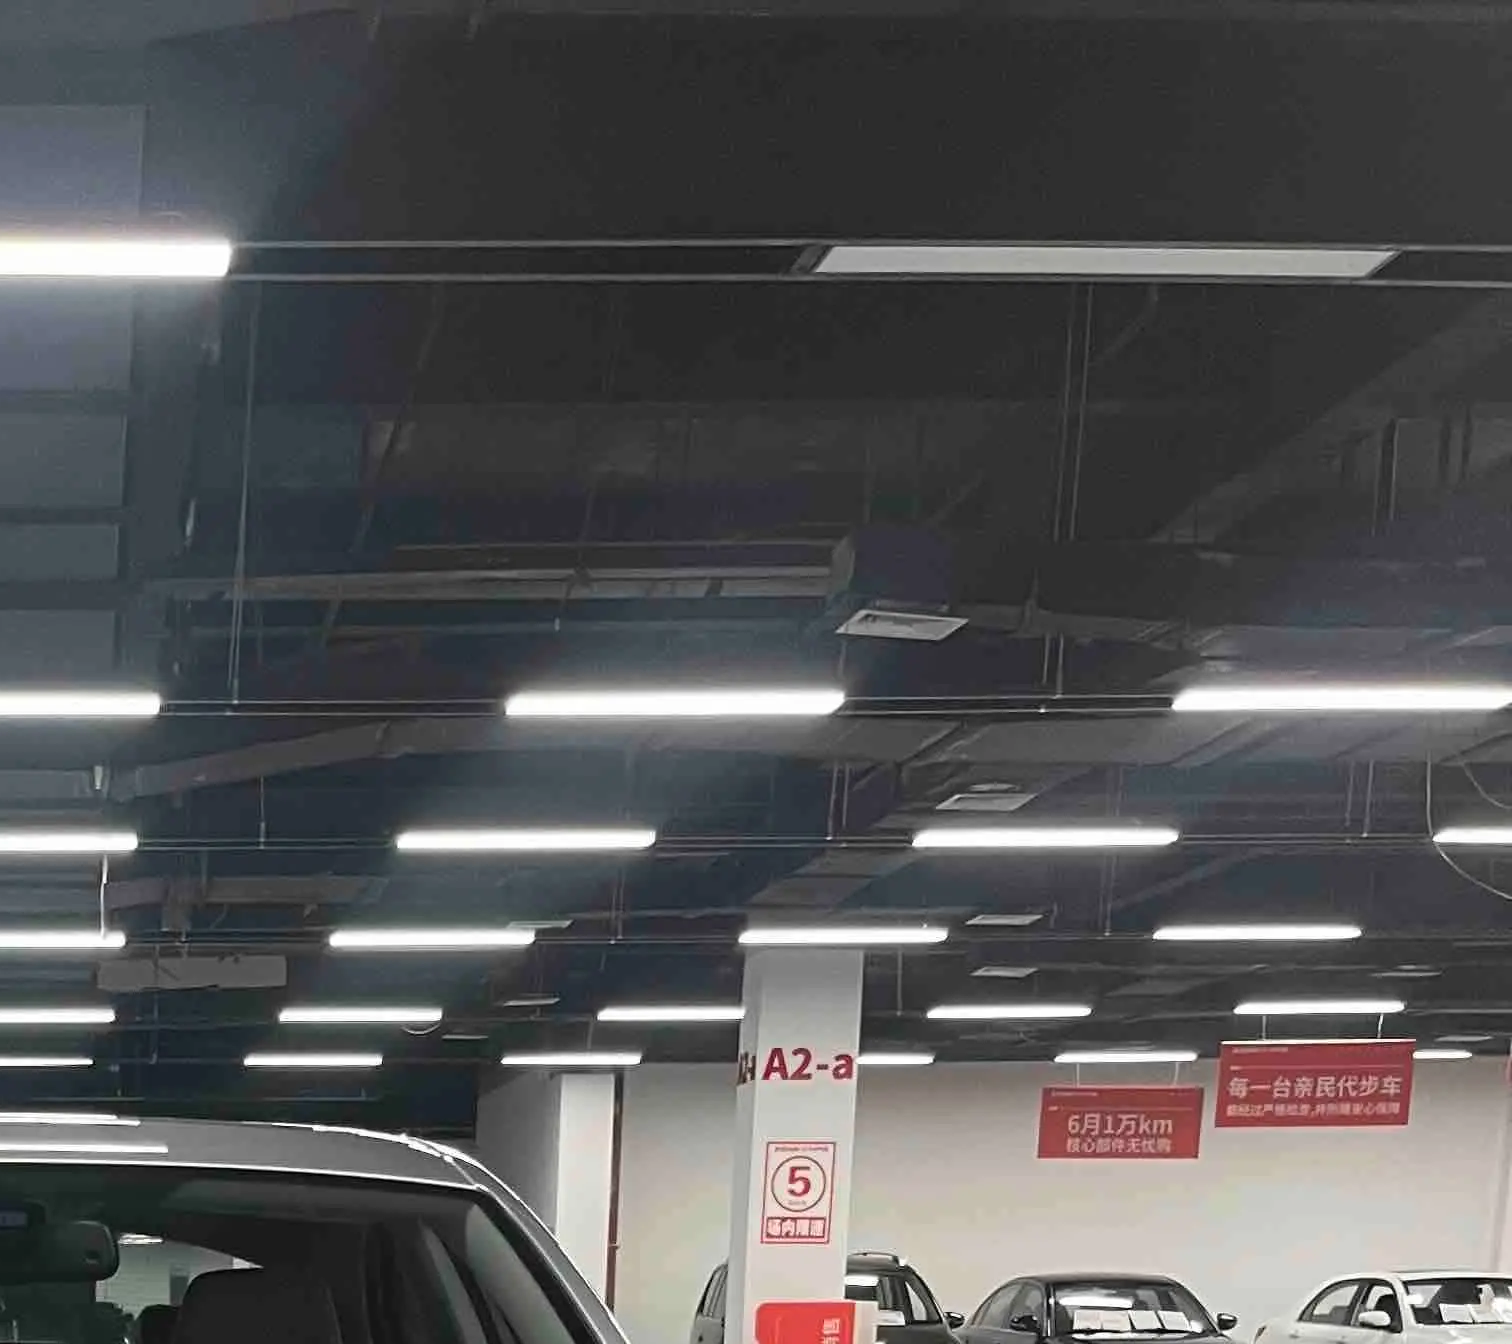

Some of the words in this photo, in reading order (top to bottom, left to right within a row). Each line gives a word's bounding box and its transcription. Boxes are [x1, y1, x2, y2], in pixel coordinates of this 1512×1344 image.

[761, 1047, 854, 1081] A2-a
[1228, 1076, 1402, 1098] 每一台亲民代步车
[1067, 1113, 1173, 1136] 6月1万km
[787, 1166, 811, 1197] 5
